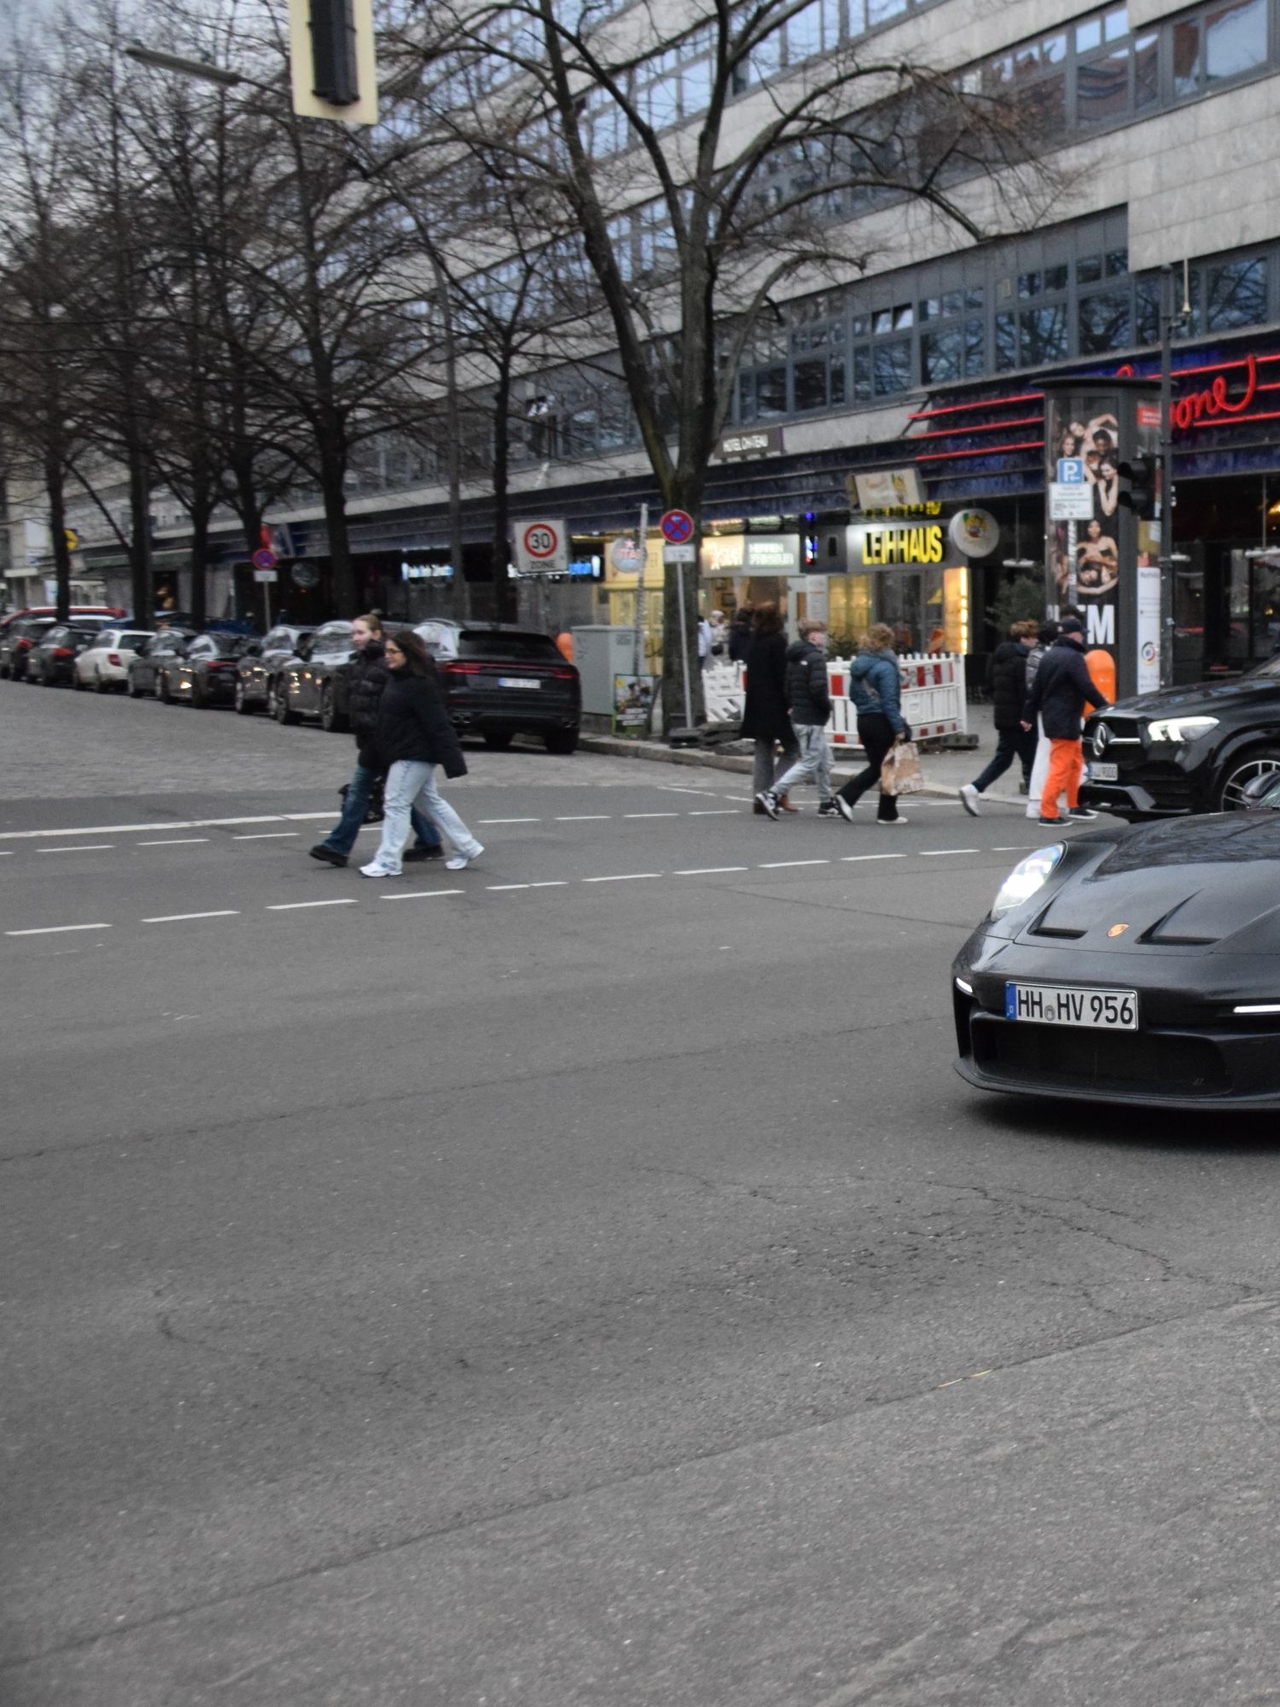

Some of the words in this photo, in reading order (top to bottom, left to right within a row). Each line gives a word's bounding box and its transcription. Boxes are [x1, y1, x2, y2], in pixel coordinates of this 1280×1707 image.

[530, 533, 550, 549] 30
[862, 525, 943, 565] LEIHHAUS
[530, 560, 555, 570] ZONE
[1018, 989, 1043, 1018] HH
[1057, 993, 1084, 1021] HV
[1090, 996, 1134, 1025] 956
